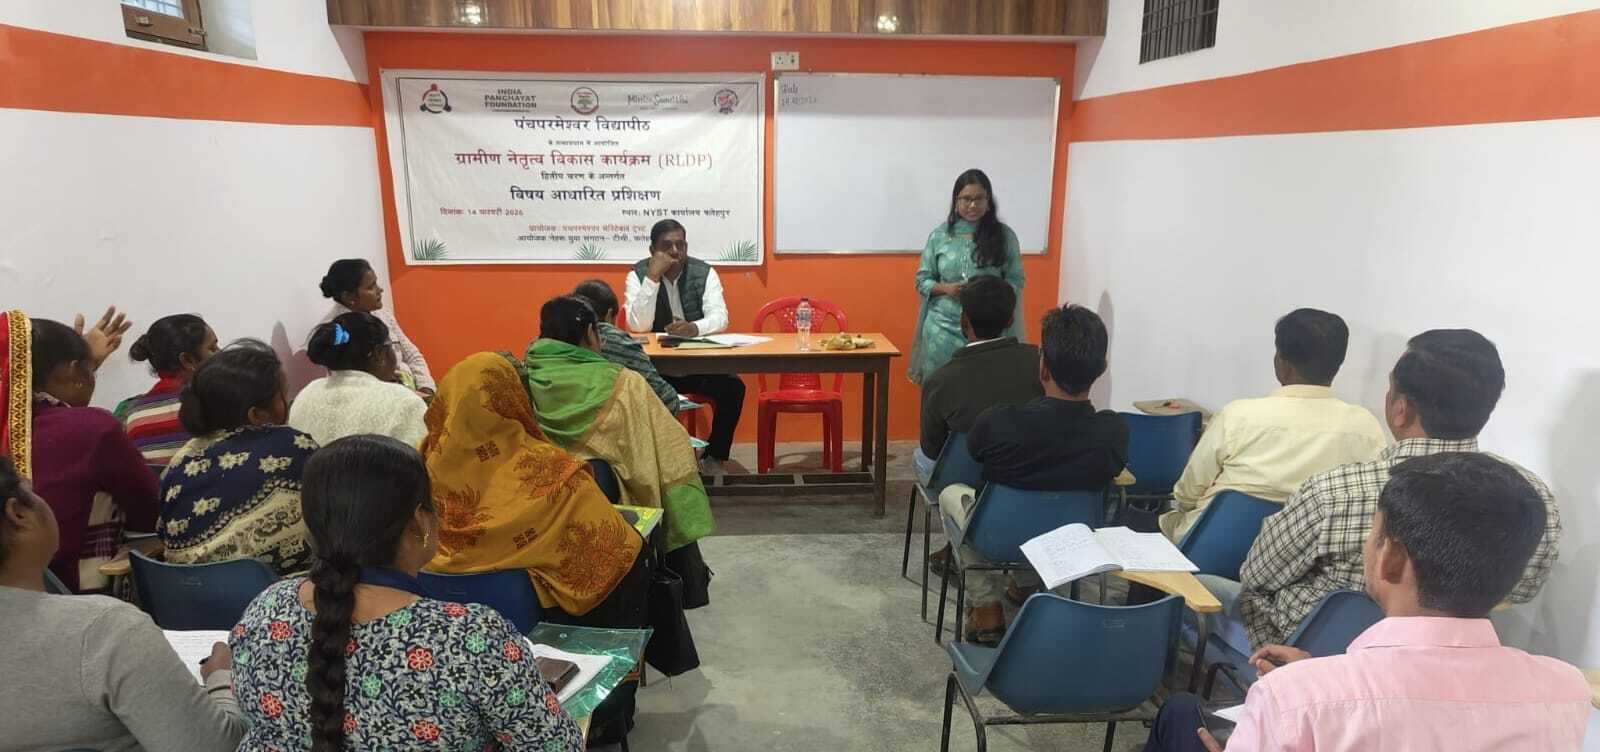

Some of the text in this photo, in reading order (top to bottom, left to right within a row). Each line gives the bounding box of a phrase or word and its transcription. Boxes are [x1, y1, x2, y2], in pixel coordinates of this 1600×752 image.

[514, 115, 651, 131] पंचपरमेश्वर विद्यापीठ
[455, 149, 713, 169] ग्रामीण नेतृत्व विकास कार्यक्रम (RLDP)
[510, 185, 662, 201] विषय आधारित प्रशिक्षण
[643, 208, 668, 217] NYST
